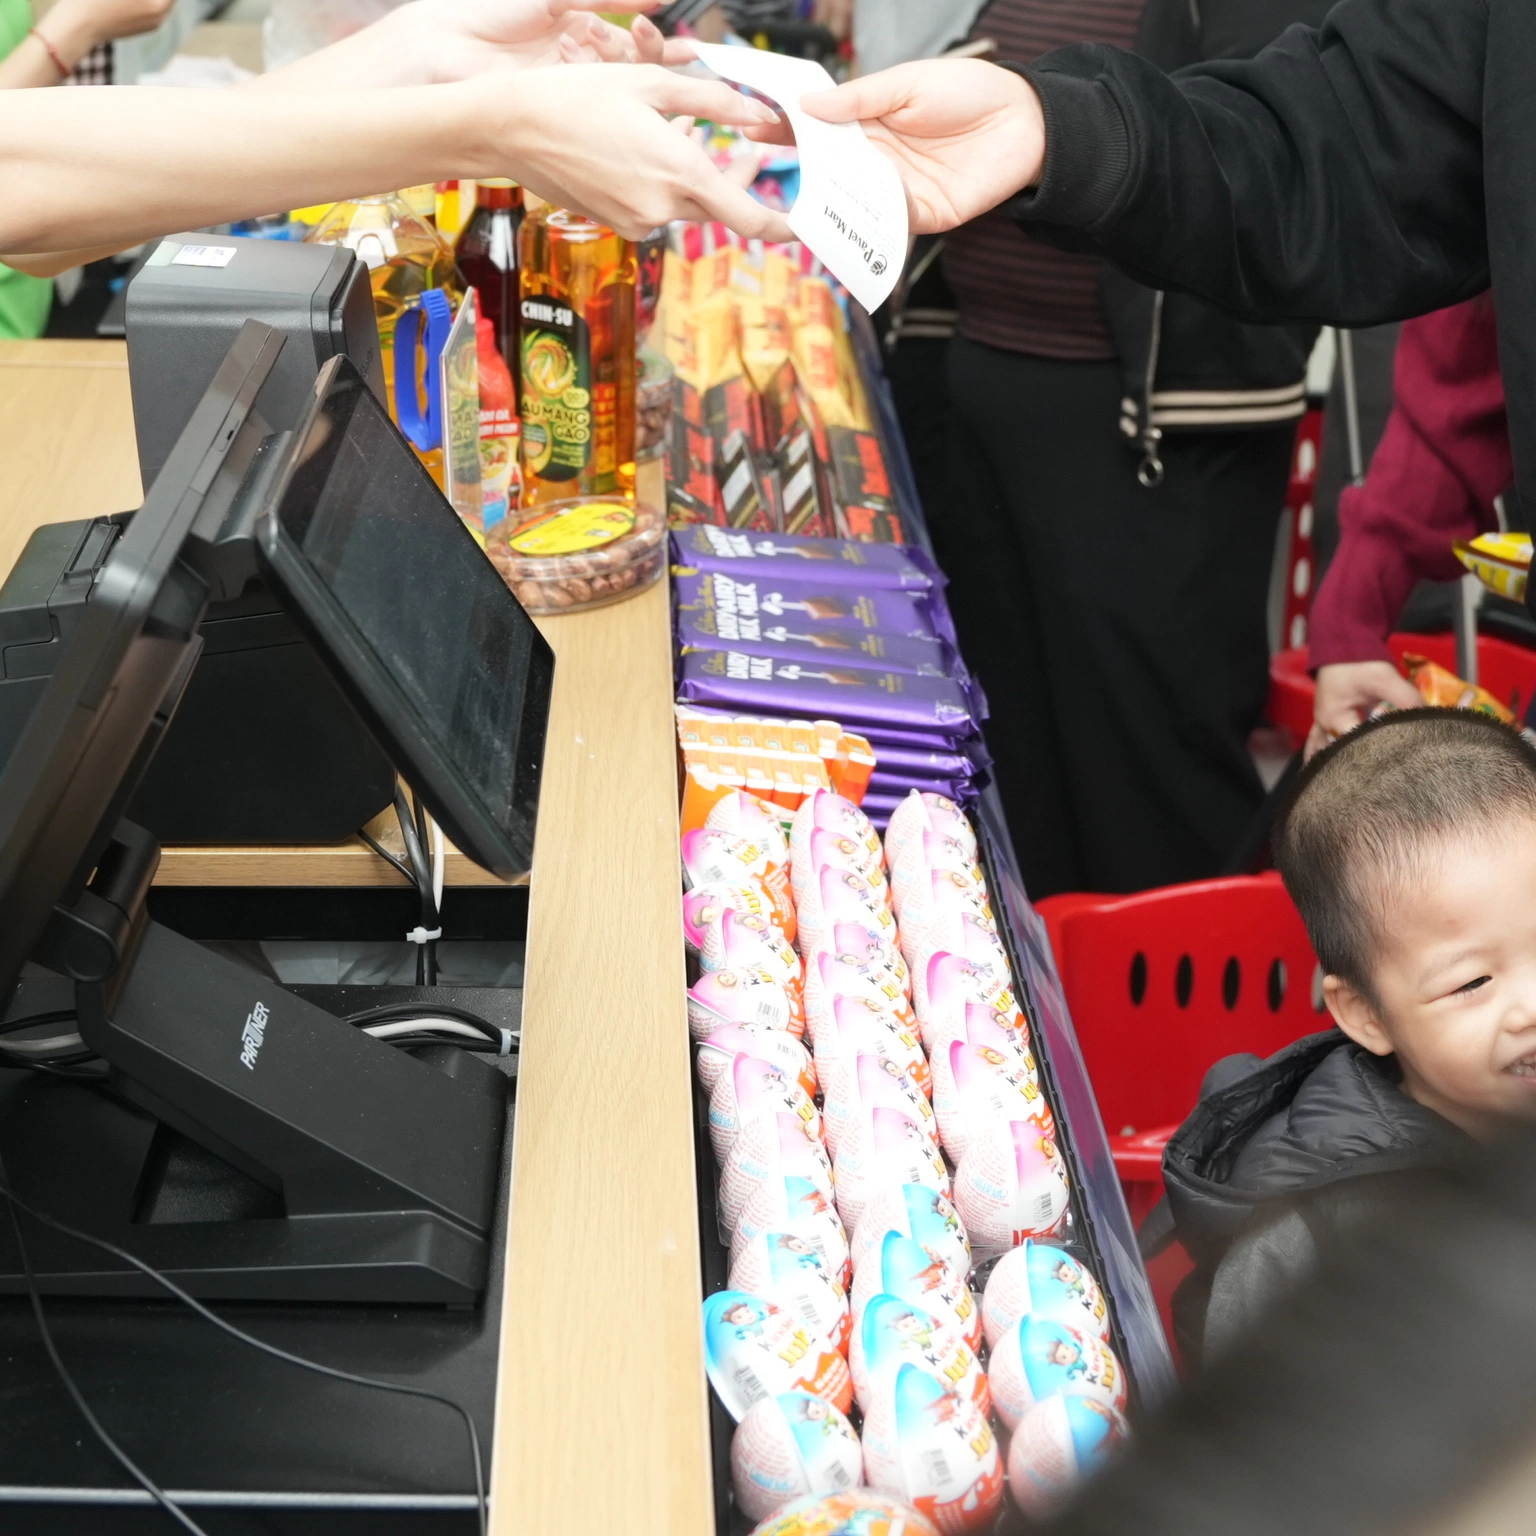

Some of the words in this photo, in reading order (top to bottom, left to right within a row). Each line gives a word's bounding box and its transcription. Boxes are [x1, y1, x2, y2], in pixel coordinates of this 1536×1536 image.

[848, 229, 874, 263] Pavel
[521, 301, 573, 327] CHIN-SU
[726, 650, 749, 680] DAIRY
[750, 656, 773, 681] MILK
[240, 1001, 270, 1070] PARTNER
